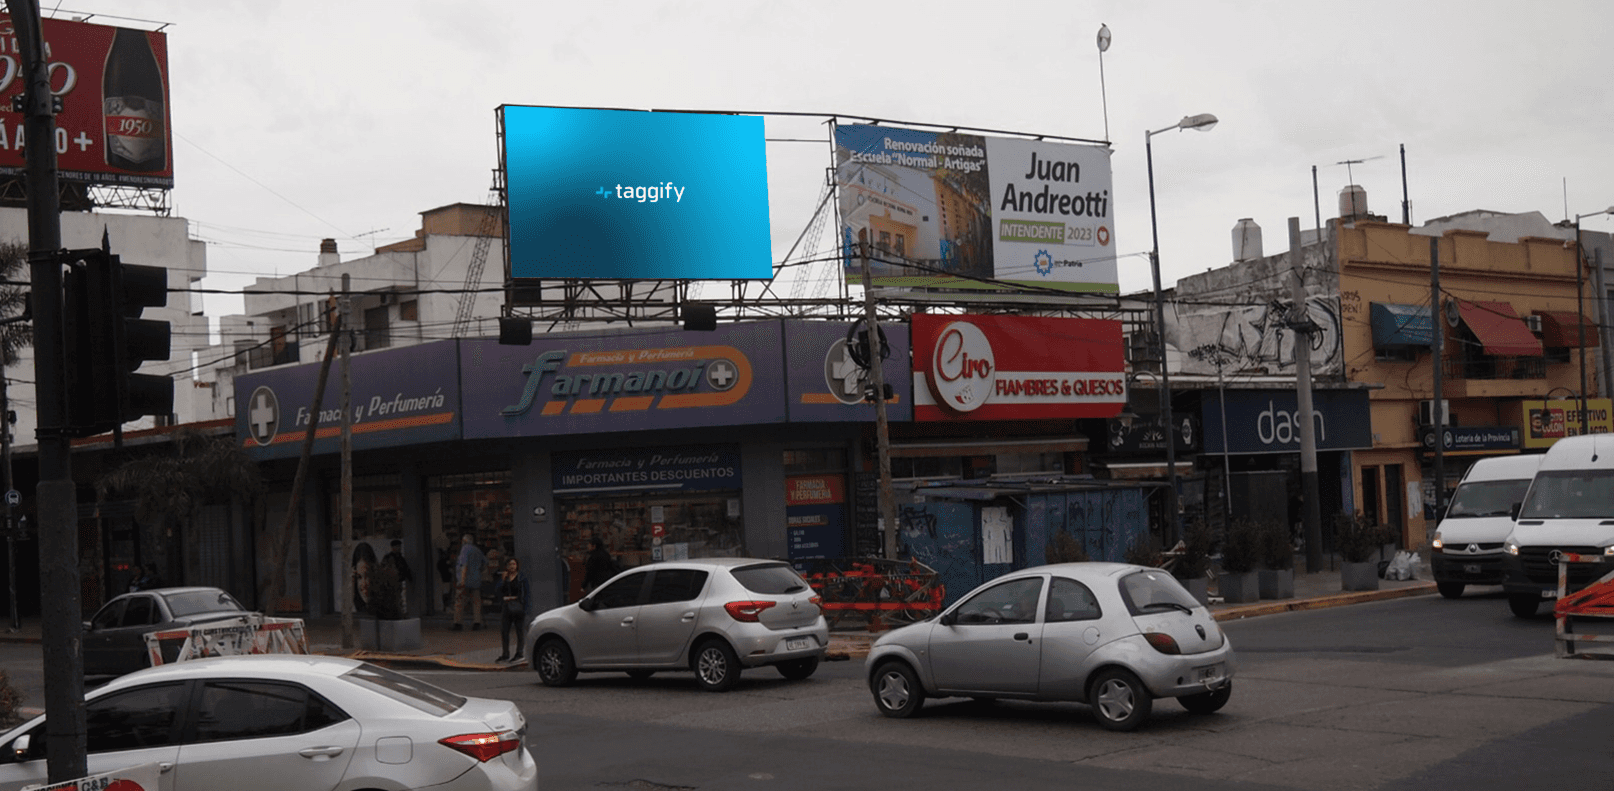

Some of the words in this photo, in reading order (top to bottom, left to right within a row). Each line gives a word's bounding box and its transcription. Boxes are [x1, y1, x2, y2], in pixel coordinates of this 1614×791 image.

[118, 118, 152, 136] 1950
[884, 137, 946, 155] Renovación
[947, 144, 984, 158] soñada
[850, 150, 892, 164] Escuela
[1025, 152, 1080, 183] Juan
[615, 181, 685, 203] taggify
[1001, 183, 1108, 218] Andreotti
[1001, 223, 1063, 240] INTENDENTE
[1067, 227, 1092, 241] 2023
[628, 354, 635, 364] y
[937, 328, 993, 382] Ciro
[995, 379, 1059, 396] FIAMBRES
[1060, 379, 1072, 396] &
[1073, 379, 1124, 396] QUESOS
[295, 406, 342, 427] Famaci
[355, 404, 364, 424] y
[367, 387, 445, 417] Perfumería
[1566, 409, 1607, 424] EFETIVO
[1474, 433, 1481, 442] de
[1482, 433, 1487, 442] la
[1487, 432, 1511, 443] Provincia
[576, 457, 632, 470] Farmacia
[637, 459, 645, 469] y
[649, 453, 719, 466] Perfumería
[562, 471, 648, 486] IMPORTANTES
[650, 467, 735, 481] DESCUENTOS
